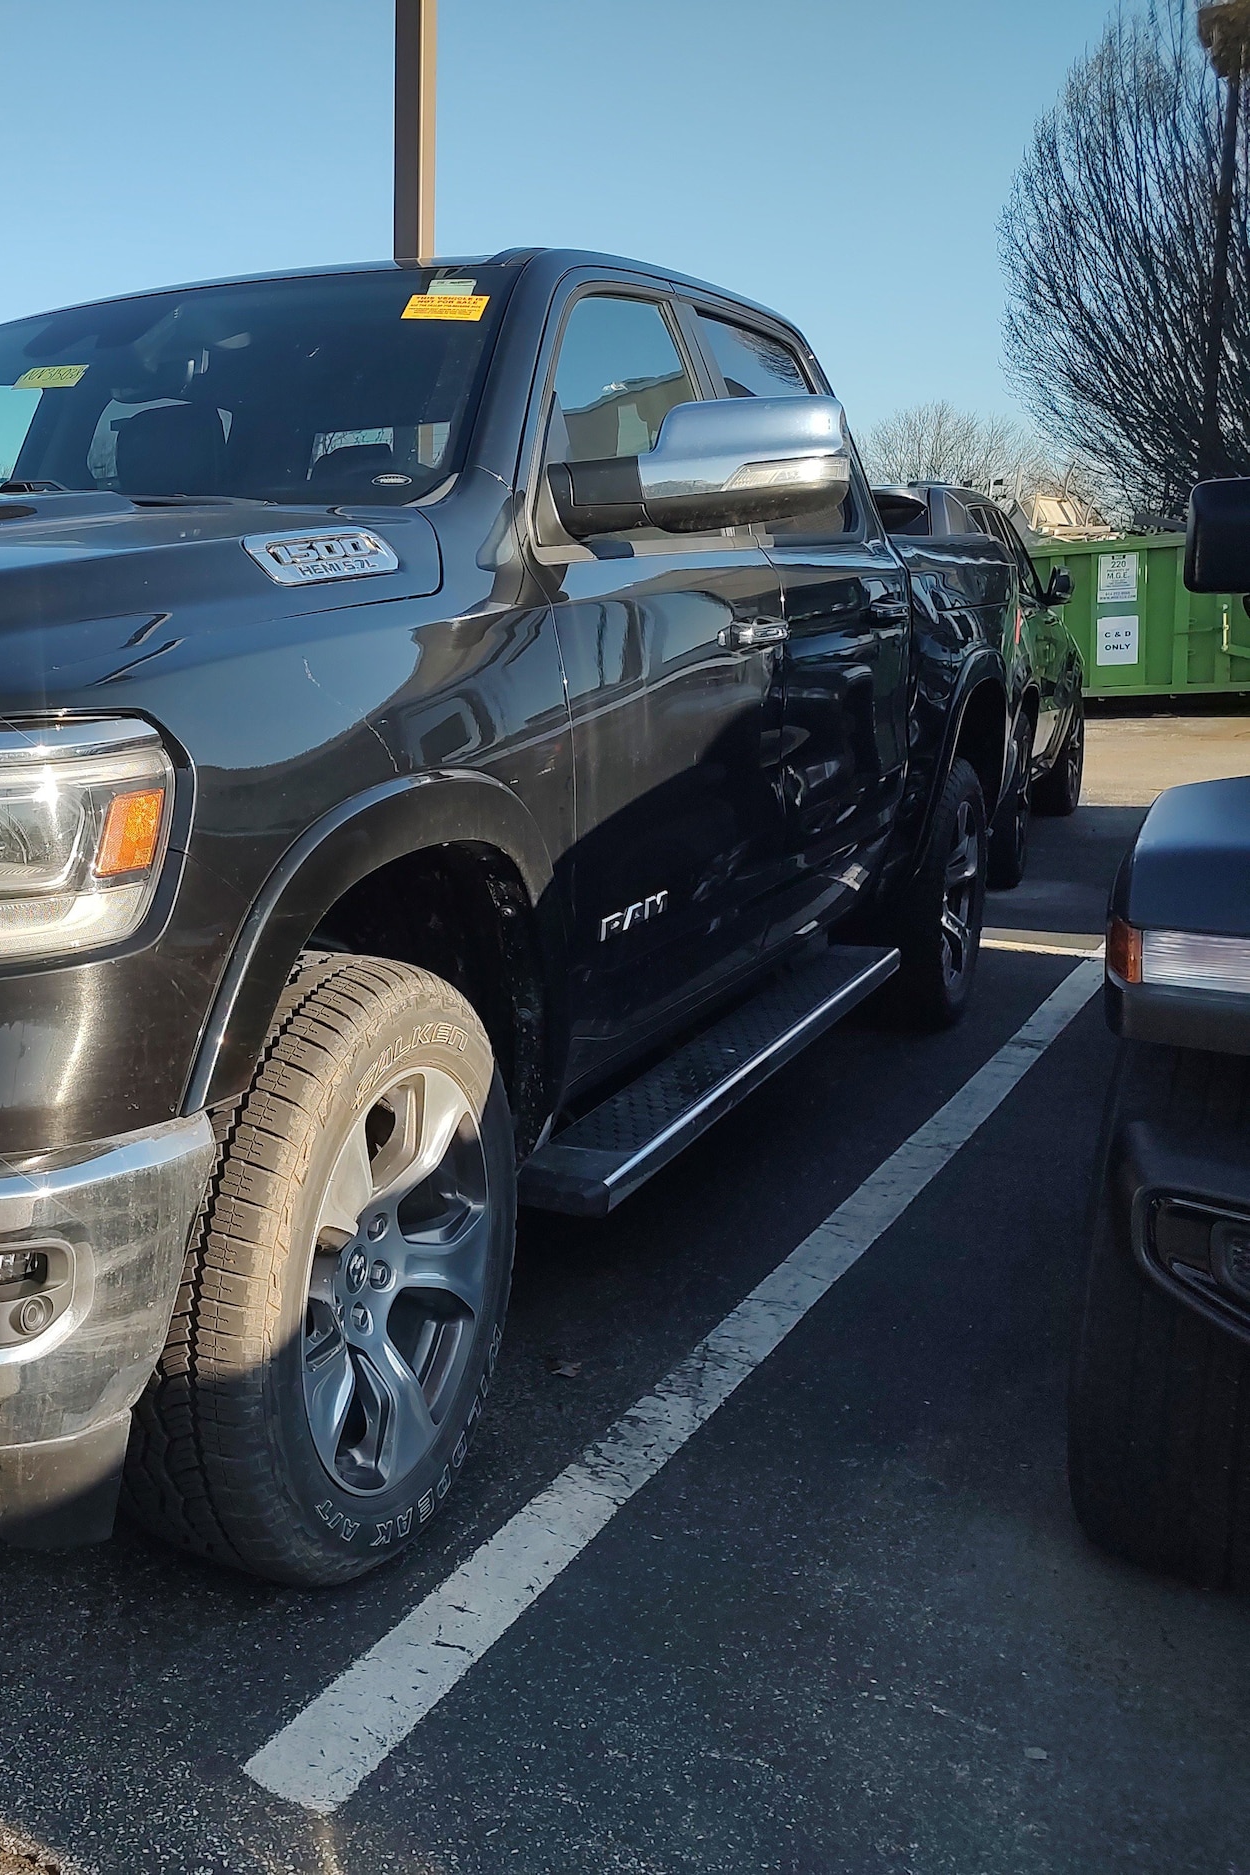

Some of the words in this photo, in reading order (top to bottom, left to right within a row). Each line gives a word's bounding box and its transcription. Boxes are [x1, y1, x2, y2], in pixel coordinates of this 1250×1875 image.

[272, 537, 371, 565] 1500
[1111, 560, 1127, 568] 220
[298, 562, 342, 577] HEMI
[343, 559, 378, 573] 5.7L
[1104, 643, 1131, 651] ONLY
[599, 889, 669, 942] RAM
[351, 1022, 469, 1110] FALKEN
[315, 1499, 361, 1542] A/T
